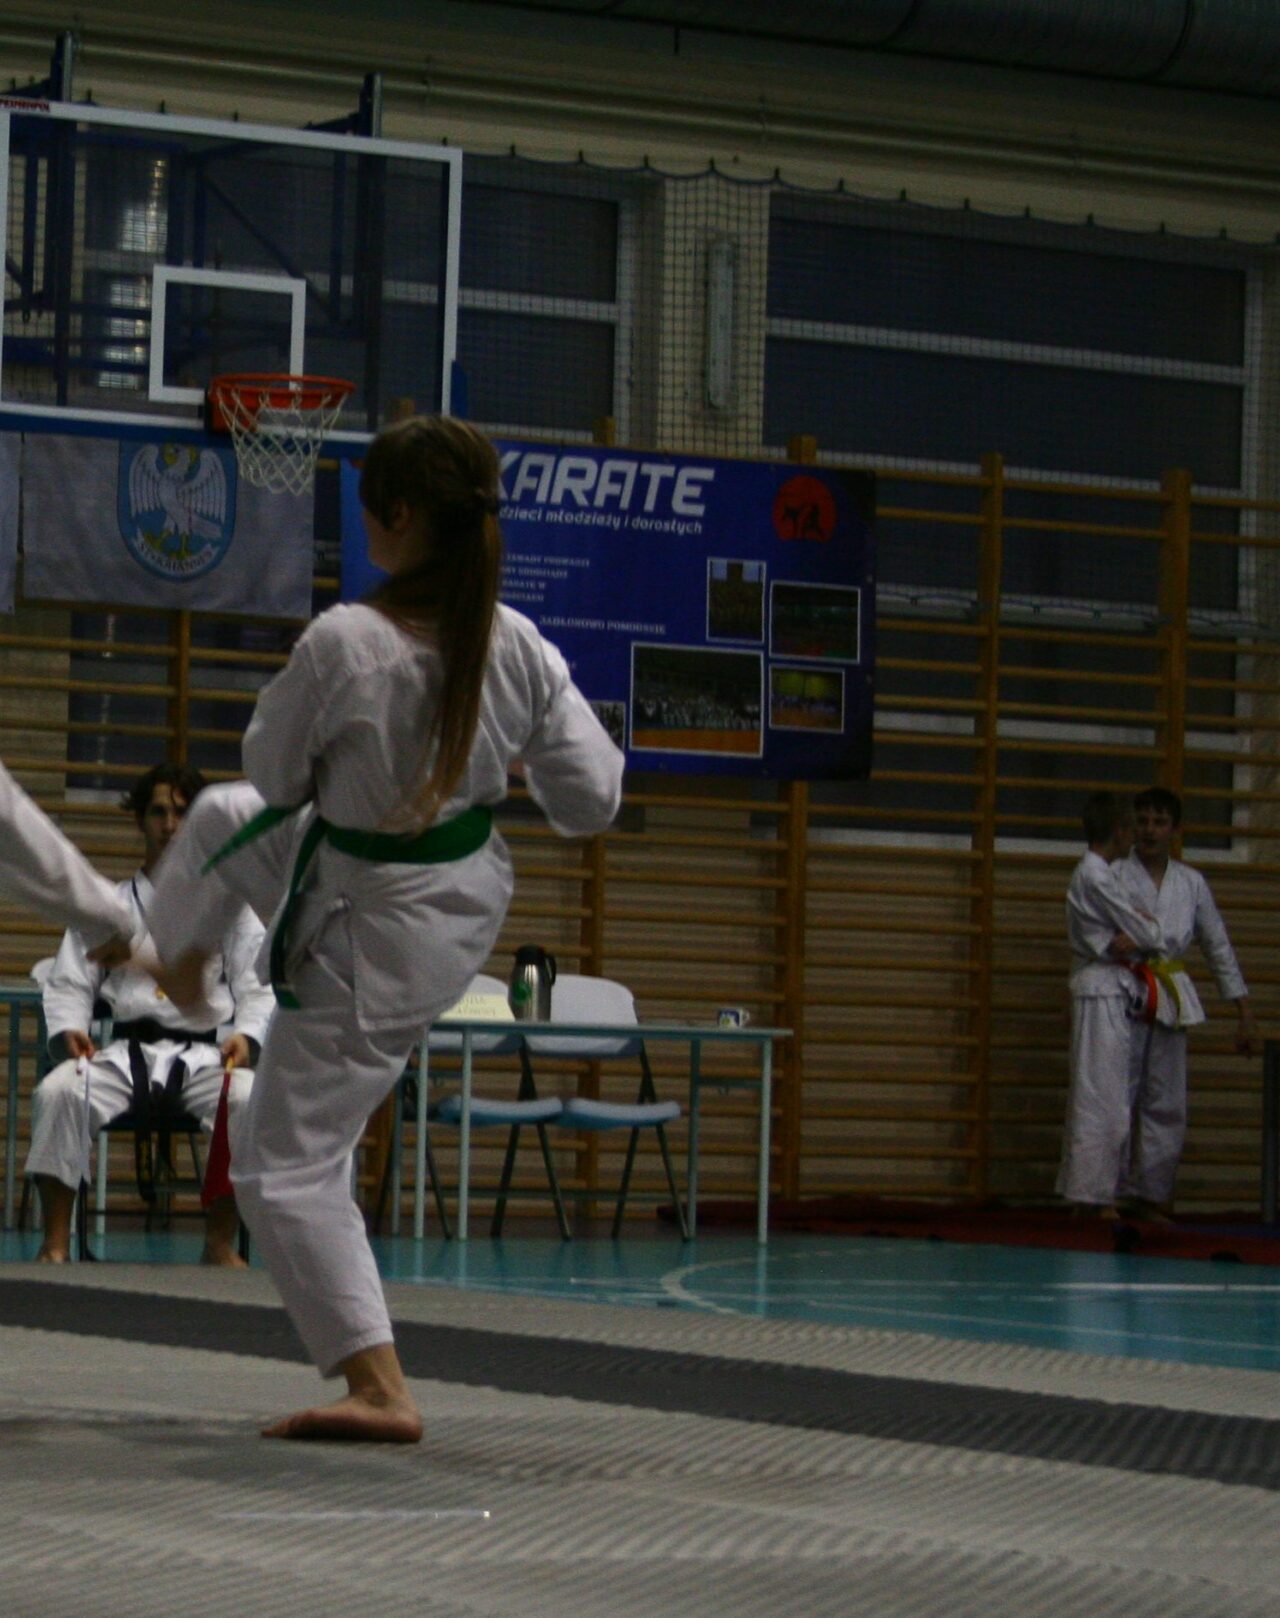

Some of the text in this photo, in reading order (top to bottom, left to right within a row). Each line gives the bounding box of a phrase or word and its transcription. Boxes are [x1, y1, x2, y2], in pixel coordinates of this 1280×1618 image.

[499, 506, 542, 522] dzieci
[545, 510, 621, 531] młodzieży
[631, 516, 703, 536] dorosłych
